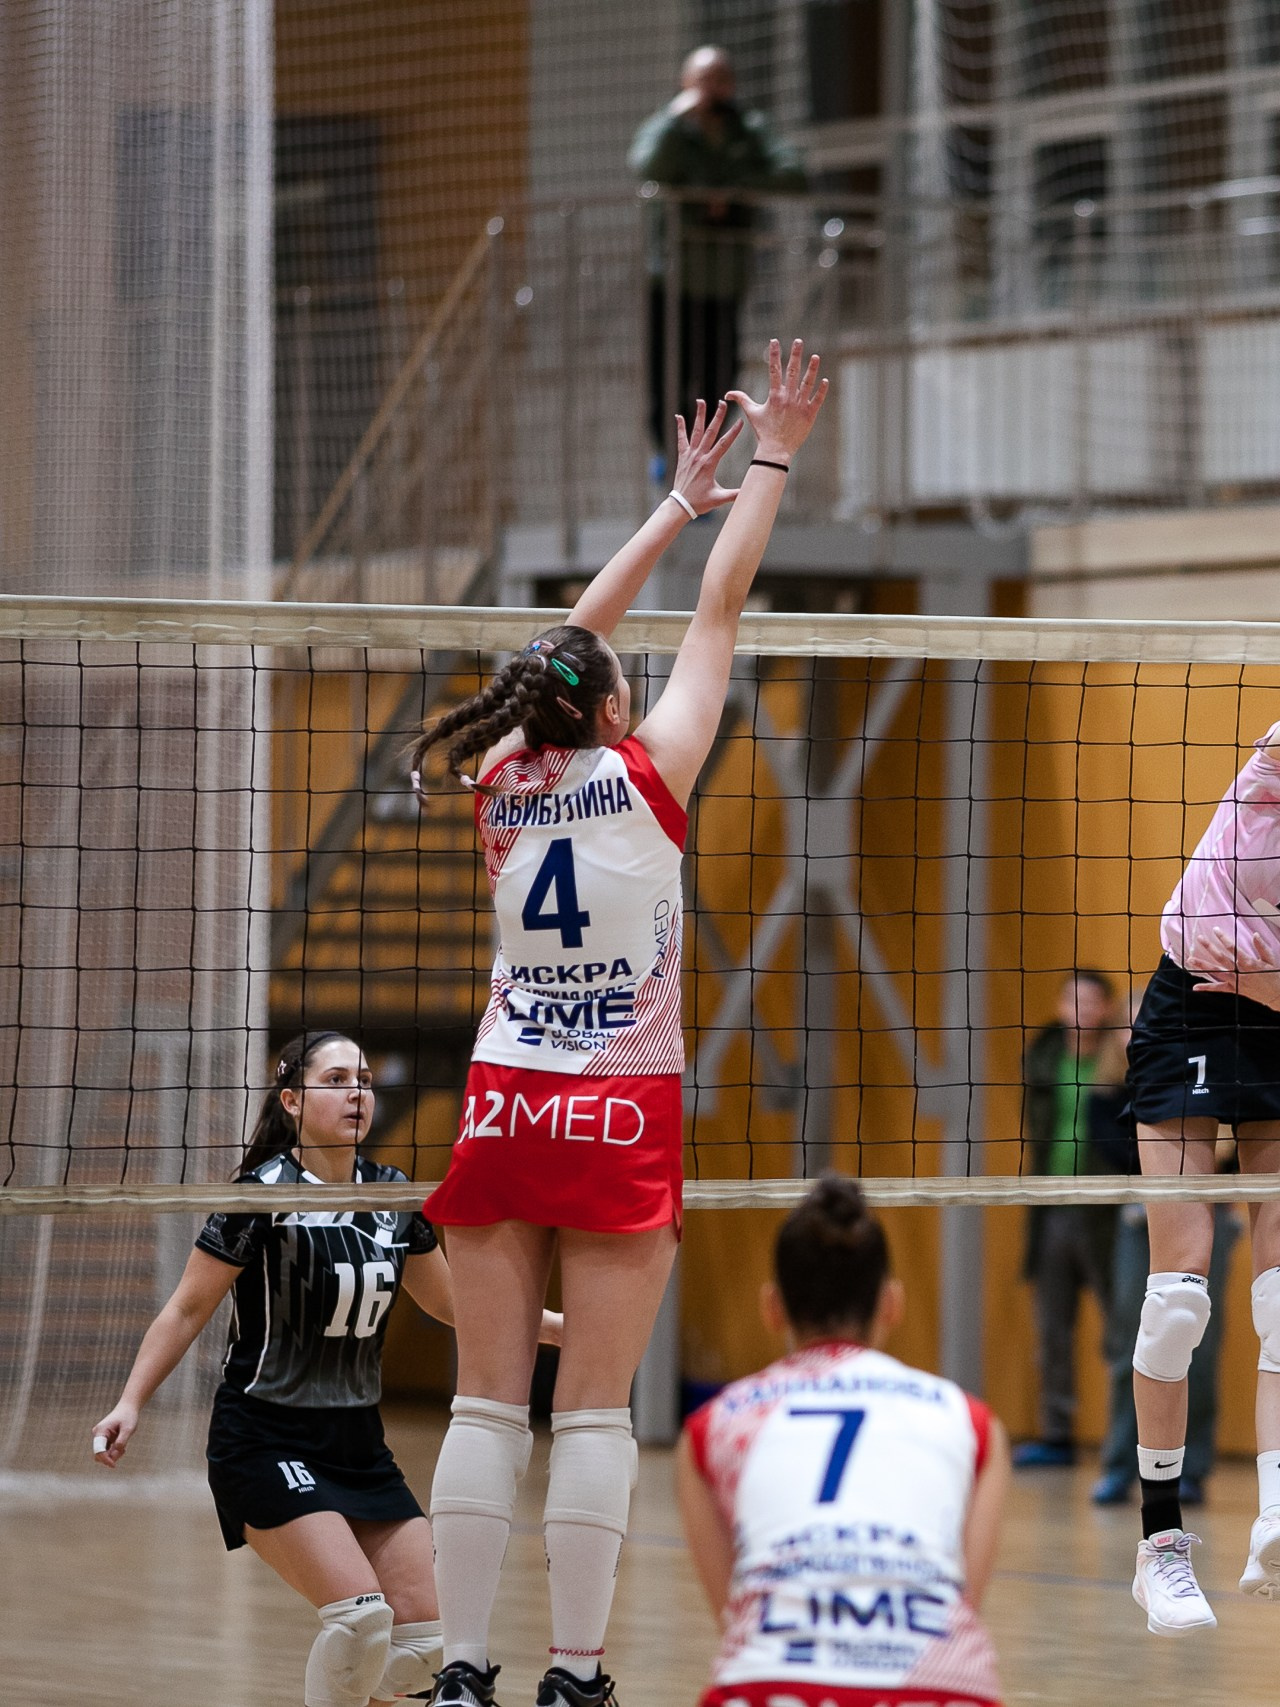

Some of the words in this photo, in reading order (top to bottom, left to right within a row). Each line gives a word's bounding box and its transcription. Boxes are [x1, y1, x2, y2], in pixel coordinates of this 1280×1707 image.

[521, 838, 591, 949] 4
[510, 957, 633, 985] ИСКРА
[551, 1040, 607, 1051] VISION
[458, 1090, 645, 1146] A2MED
[324, 1262, 395, 1338] 16
[277, 1461, 316, 1490] 16
[788, 1408, 867, 1504] 7
[760, 1591, 950, 1639] LIME
